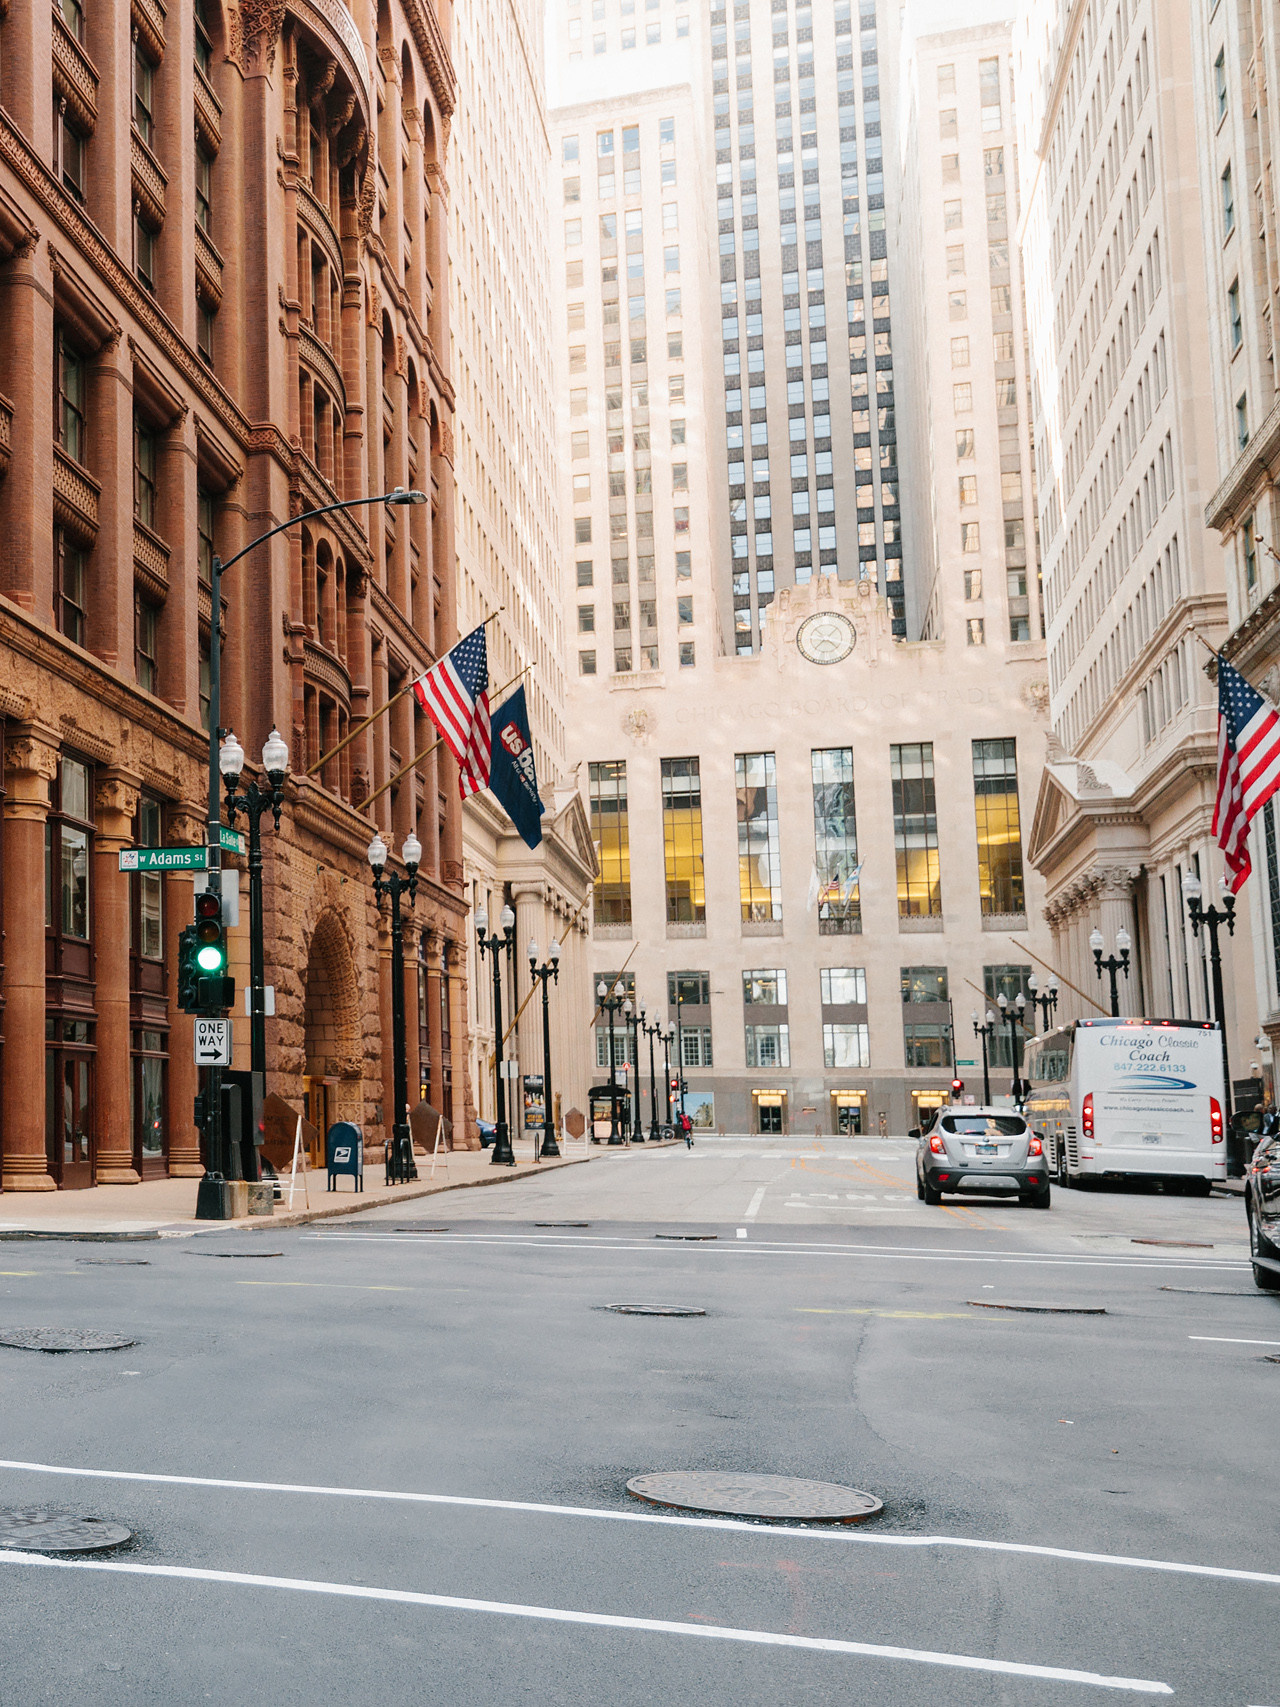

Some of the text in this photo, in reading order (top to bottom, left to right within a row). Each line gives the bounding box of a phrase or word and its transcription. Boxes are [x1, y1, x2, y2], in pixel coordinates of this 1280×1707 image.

[674, 702, 780, 725] CHICAGO
[791, 695, 869, 717] BOARD
[149, 853, 191, 865] Adams
[194, 853, 203, 861] St
[198, 1023, 224, 1034] ONE
[198, 1035, 224, 1046] WAY
[1099, 1034, 1199, 1049] Chicago Classic
[1128, 1049, 1170, 1062] Coach
[1114, 1063, 1186, 1073] 847.222.6133
